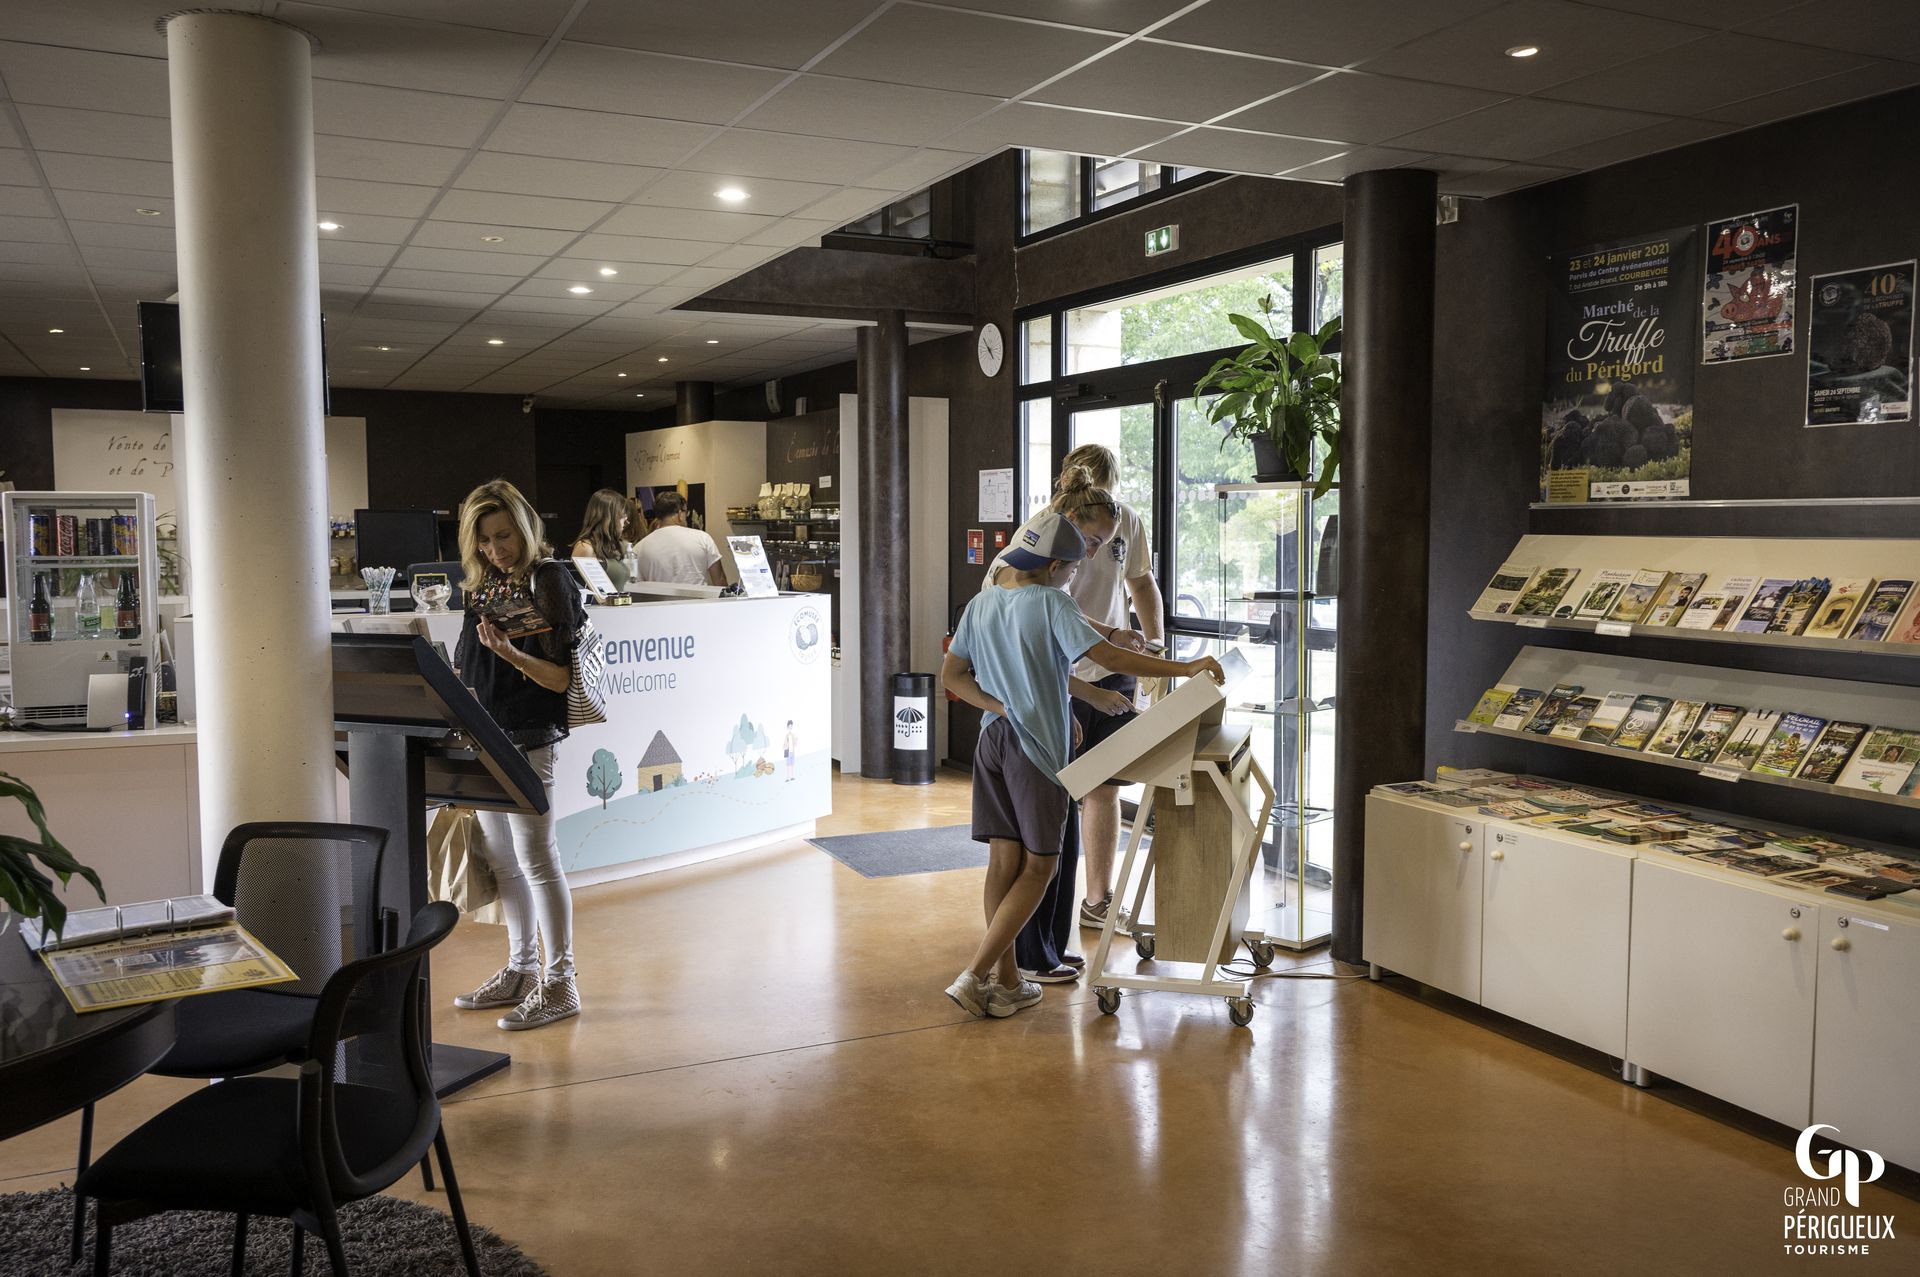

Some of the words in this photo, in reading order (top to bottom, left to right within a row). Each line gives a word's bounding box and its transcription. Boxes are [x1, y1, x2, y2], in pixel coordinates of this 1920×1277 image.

[1570, 260, 1580, 272] 23
[1583, 260, 1591, 269] et
[1594, 256, 1605, 267] 24
[1607, 249, 1642, 265] janvier
[1645, 243, 1670, 257] 2021
[1570, 272, 1587, 280] Parvis
[1598, 266, 1619, 275] Centre
[1621, 257, 1669, 271] événementiel
[1619, 267, 1668, 280] COURBEVOIE
[1583, 298, 1634, 319] Marché
[1633, 306, 1646, 318] de
[1650, 304, 1660, 316] la
[1567, 317, 1665, 366] Truffe
[1566, 367, 1582, 383] du
[1587, 355, 1664, 381] Périgord
[108, 436, 144, 450] Vente
[153, 432, 169, 451] de
[109, 466, 122, 475] et
[131, 458, 147, 475] de
[606, 669, 677, 695] Welcome
